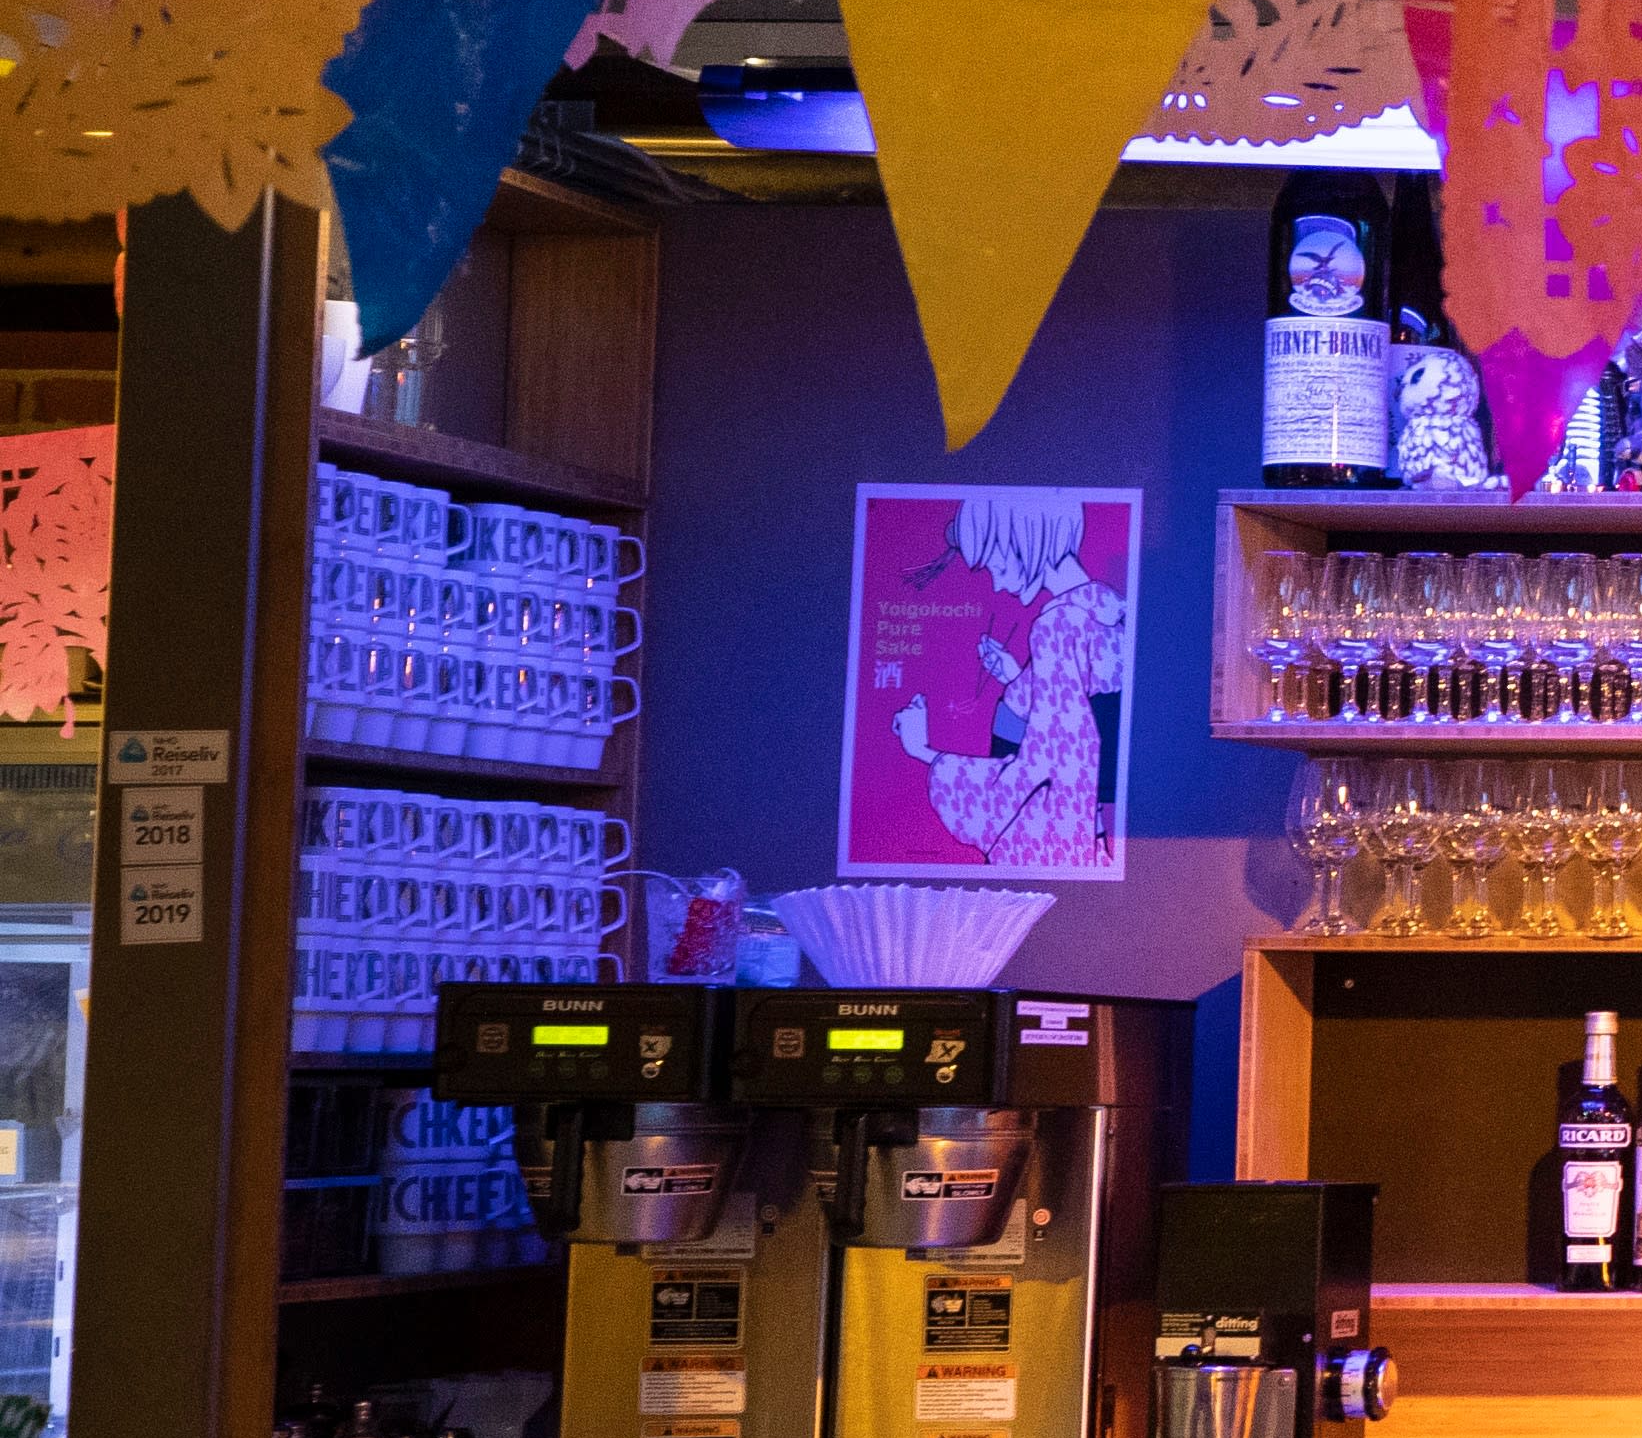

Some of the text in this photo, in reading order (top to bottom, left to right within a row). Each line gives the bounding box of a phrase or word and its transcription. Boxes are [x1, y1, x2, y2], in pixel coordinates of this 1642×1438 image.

[875, 620, 923, 636] Pure
[874, 640, 924, 657] Sake
[152, 746, 221, 762] Reiseliv
[151, 764, 184, 777] 2017
[135, 825, 192, 845] 2018
[134, 904, 192, 925] 2019
[541, 999, 604, 1013] BUNN
[837, 1003, 900, 1017] BUNN
[1561, 1129, 1626, 1143] RICARD
